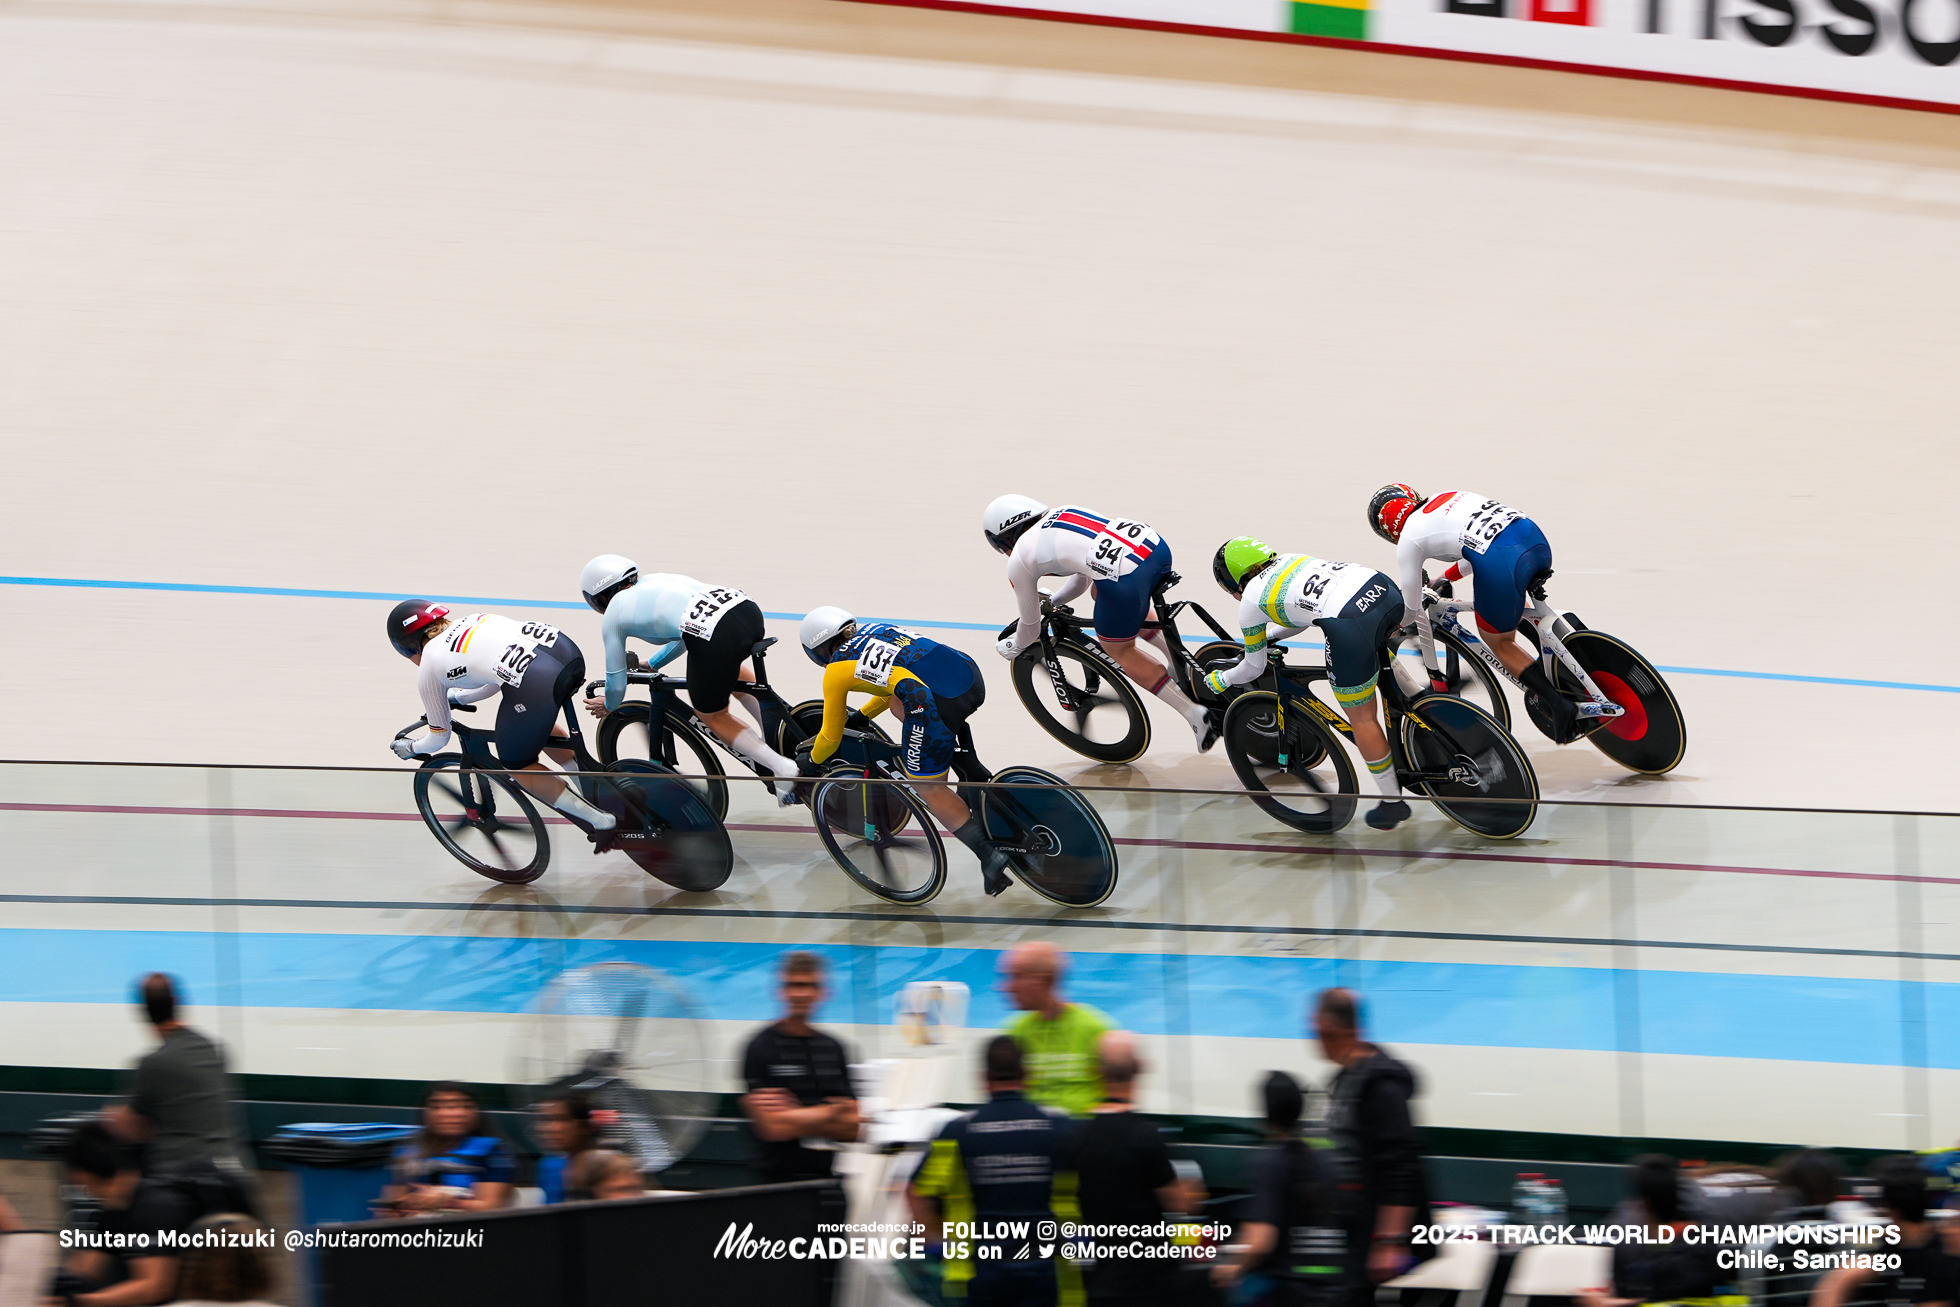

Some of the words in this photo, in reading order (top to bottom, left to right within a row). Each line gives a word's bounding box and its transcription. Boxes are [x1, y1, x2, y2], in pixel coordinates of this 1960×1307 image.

[999, 510, 1032, 531] LAZER
[1466, 510, 1503, 541] 116
[1095, 538, 1123, 566] 94
[1303, 573, 1331, 600] 64
[690, 599, 720, 623] 57
[446, 665, 468, 679] KTM
[500, 643, 534, 674] 100
[862, 642, 897, 673] 137
[1046, 660, 1070, 705] LOTUS
[906, 724, 925, 772] UKRAINE
